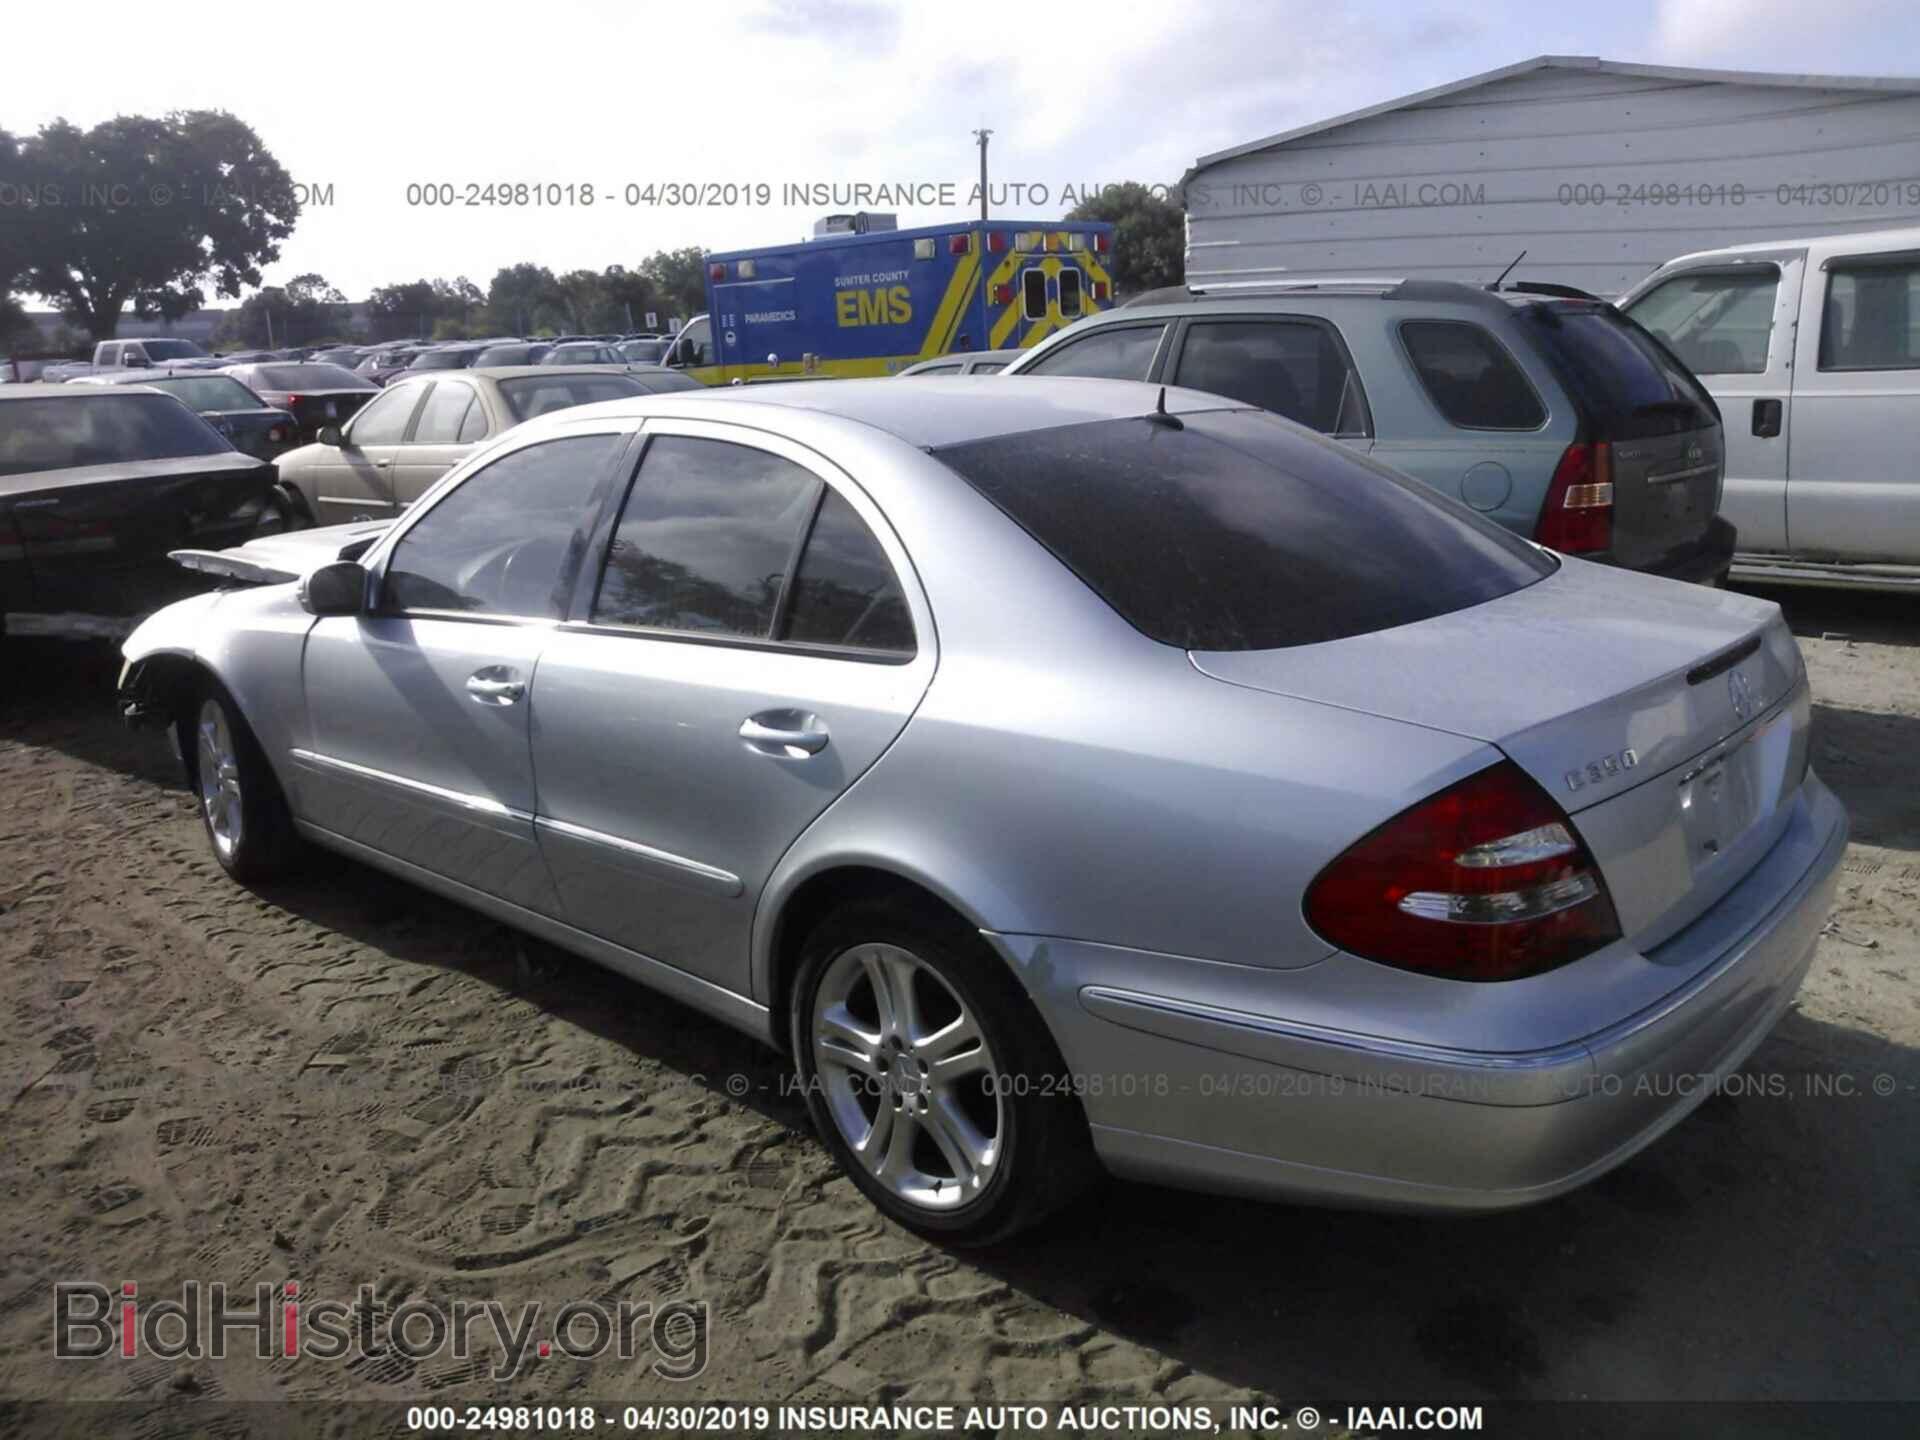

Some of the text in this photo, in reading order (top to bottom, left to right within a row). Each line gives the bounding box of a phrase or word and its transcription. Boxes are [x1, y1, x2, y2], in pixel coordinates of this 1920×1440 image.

[873, 270, 910, 283] COUNTY
[836, 287, 912, 327] EMS
[744, 310, 796, 325] PARAMEDICS
